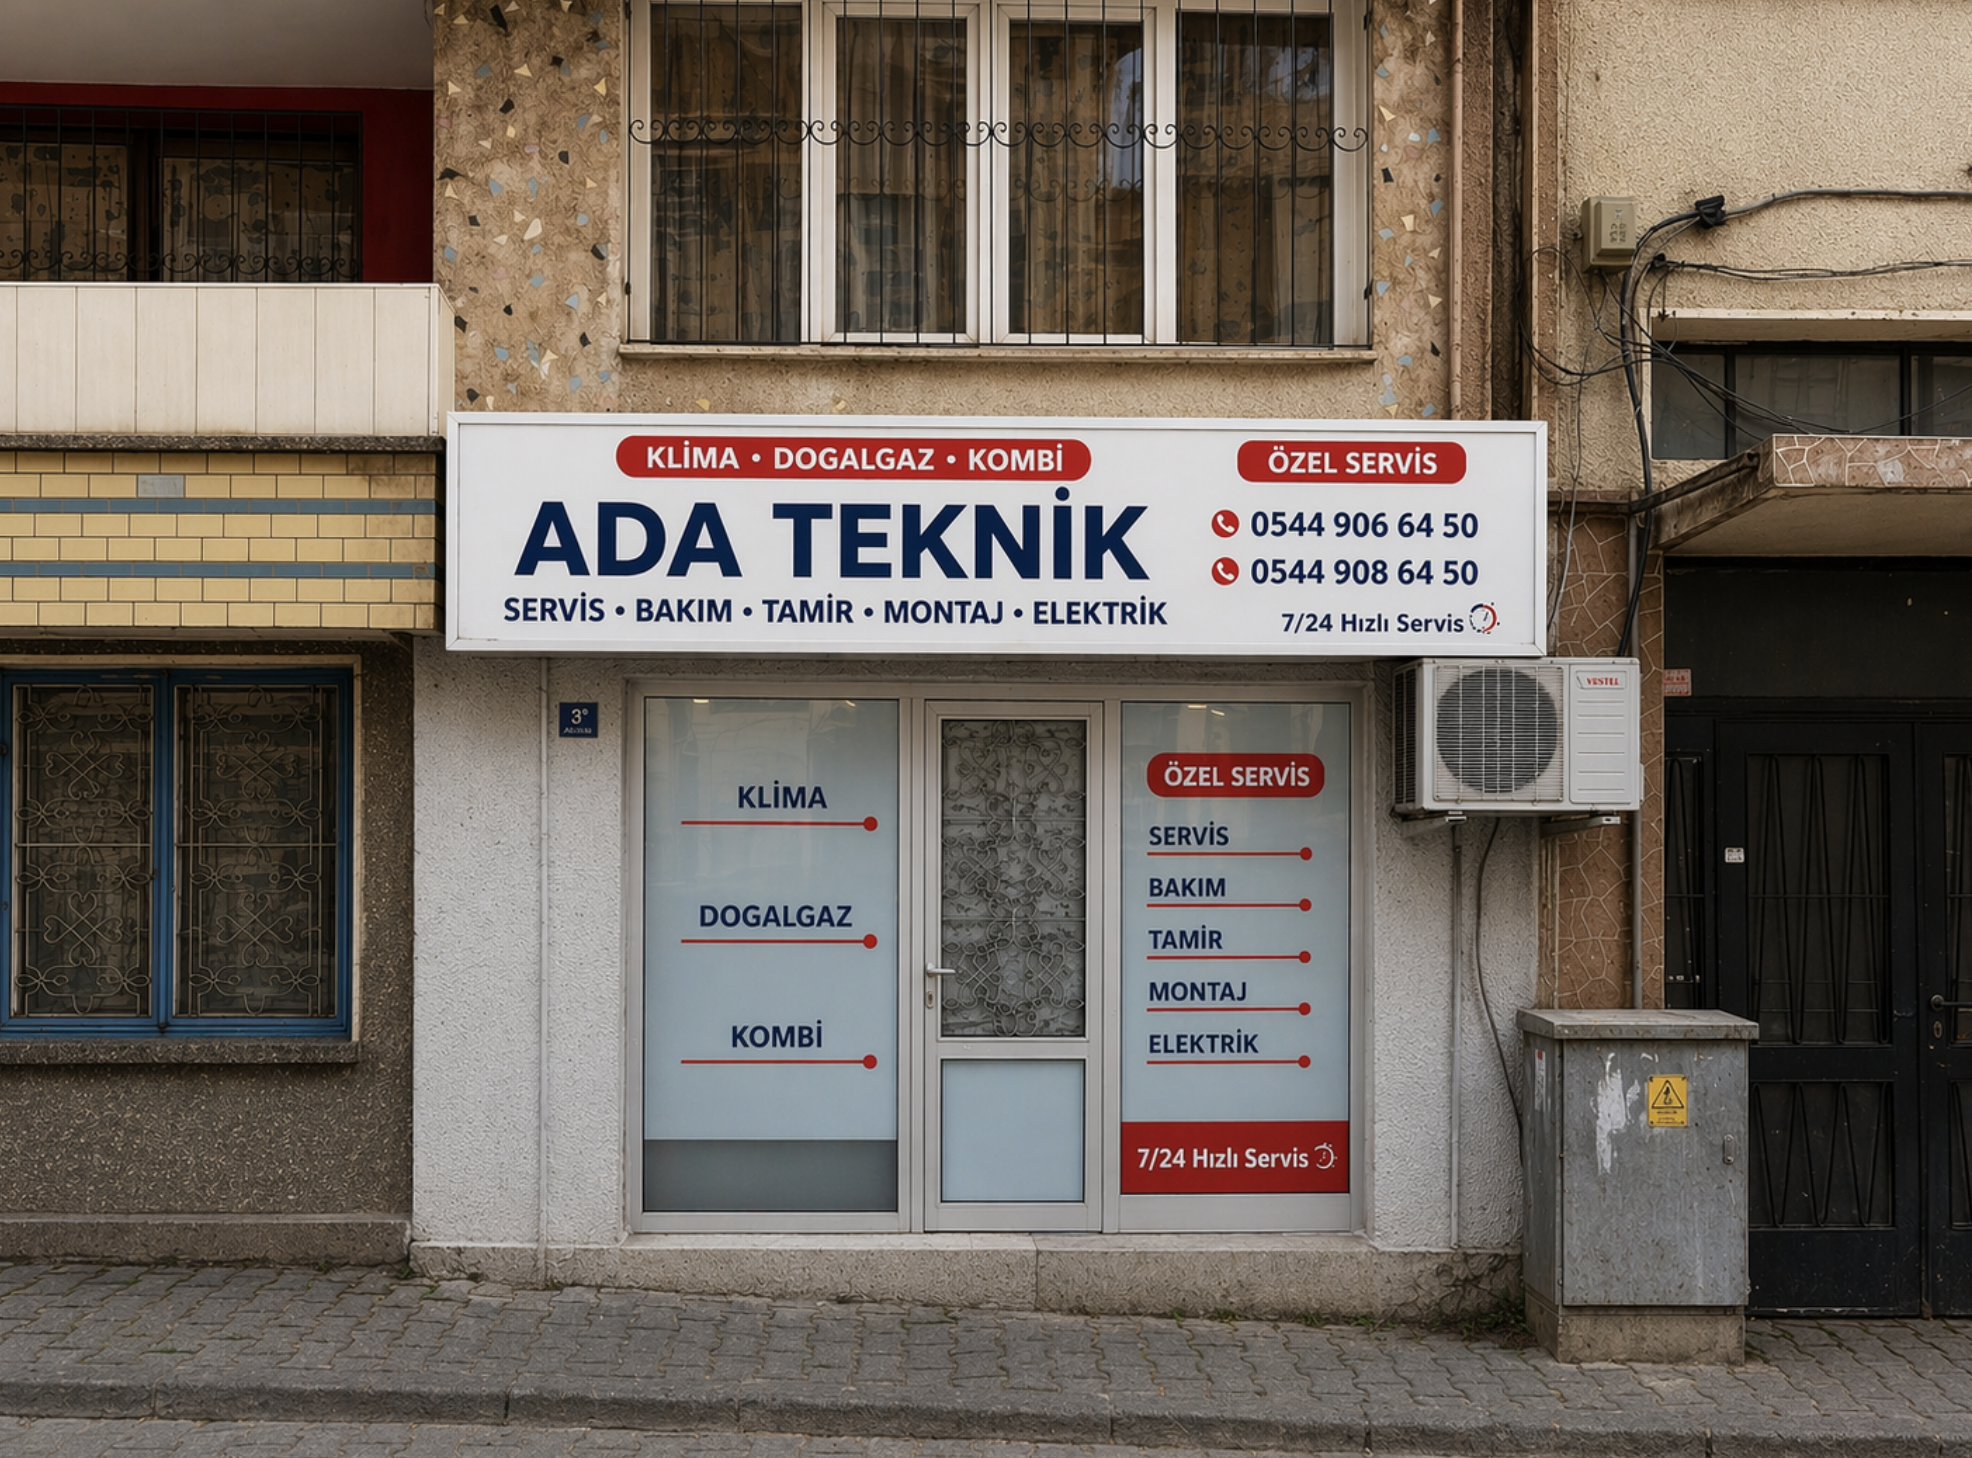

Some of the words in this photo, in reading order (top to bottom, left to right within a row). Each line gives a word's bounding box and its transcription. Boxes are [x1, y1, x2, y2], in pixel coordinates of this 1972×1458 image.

[646, 439, 739, 470] KLİMA
[774, 446, 935, 471] DOGALGAZ
[968, 442, 1063, 472] KOMBİ
[1267, 445, 1338, 474] ÖZEL
[1345, 446, 1438, 475] SERVİS
[514, 501, 743, 578] ADA
[772, 486, 1150, 581] TEKNİK
[1250, 510, 1326, 538] 0544
[1333, 511, 1389, 538] 906
[1397, 512, 1435, 539] 64
[1442, 512, 1479, 539] 50
[1250, 558, 1326, 585] 0544
[1333, 559, 1389, 585] 908
[1397, 559, 1435, 586] 64
[1442, 559, 1479, 586] 50
[504, 591, 605, 623] SERVİS
[636, 598, 732, 623] BAKIM
[761, 592, 854, 624] TAMİR
[884, 599, 1003, 625] MONTAJ
[1033, 595, 1168, 625] ELEKTRİK
[1281, 613, 1334, 634] 7/24
[1341, 613, 1389, 633] Hızlı
[1396, 613, 1465, 633] Servis
[1164, 760, 1225, 787] ÖZEL
[1231, 761, 1310, 787] SERVİS
[738, 779, 828, 810] KLİMA
[1149, 820, 1230, 847] SERVİS
[1149, 877, 1226, 898] BAKIM
[699, 904, 853, 928] DOGALGAZ
[1148, 924, 1223, 950] TAMİR
[1149, 981, 1247, 1002] MONTAJ
[731, 1019, 823, 1049] KOMBİ
[1149, 1028, 1259, 1054] ELEKTRİK
[1137, 1147, 1186, 1171] 7/24
[1192, 1146, 1239, 1169] Hızlı
[1244, 1147, 1309, 1169] Servis
